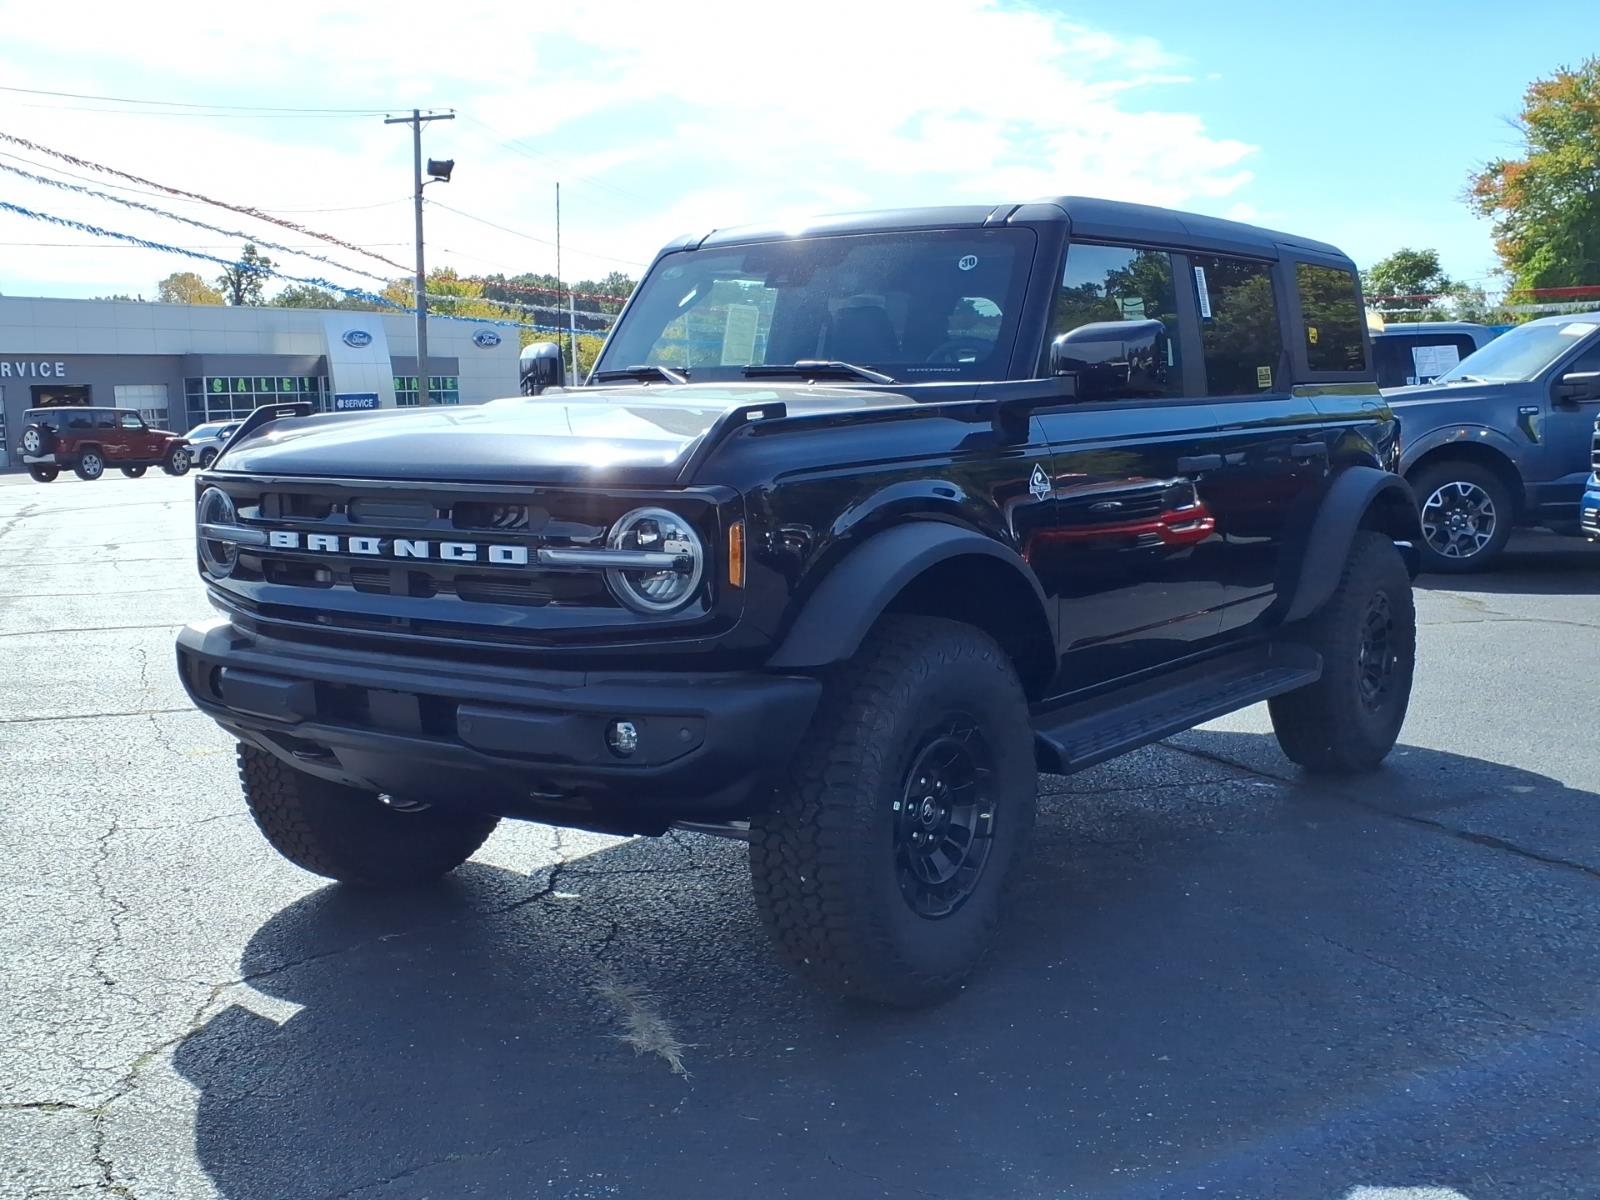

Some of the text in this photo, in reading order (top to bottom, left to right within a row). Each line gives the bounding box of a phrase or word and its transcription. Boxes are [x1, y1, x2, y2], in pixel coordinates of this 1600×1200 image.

[0, 362, 65, 377] RVICE
[213, 378, 310, 393] SALE!
[345, 399, 373, 408] SERVICE
[269, 531, 528, 565] BRONCO
